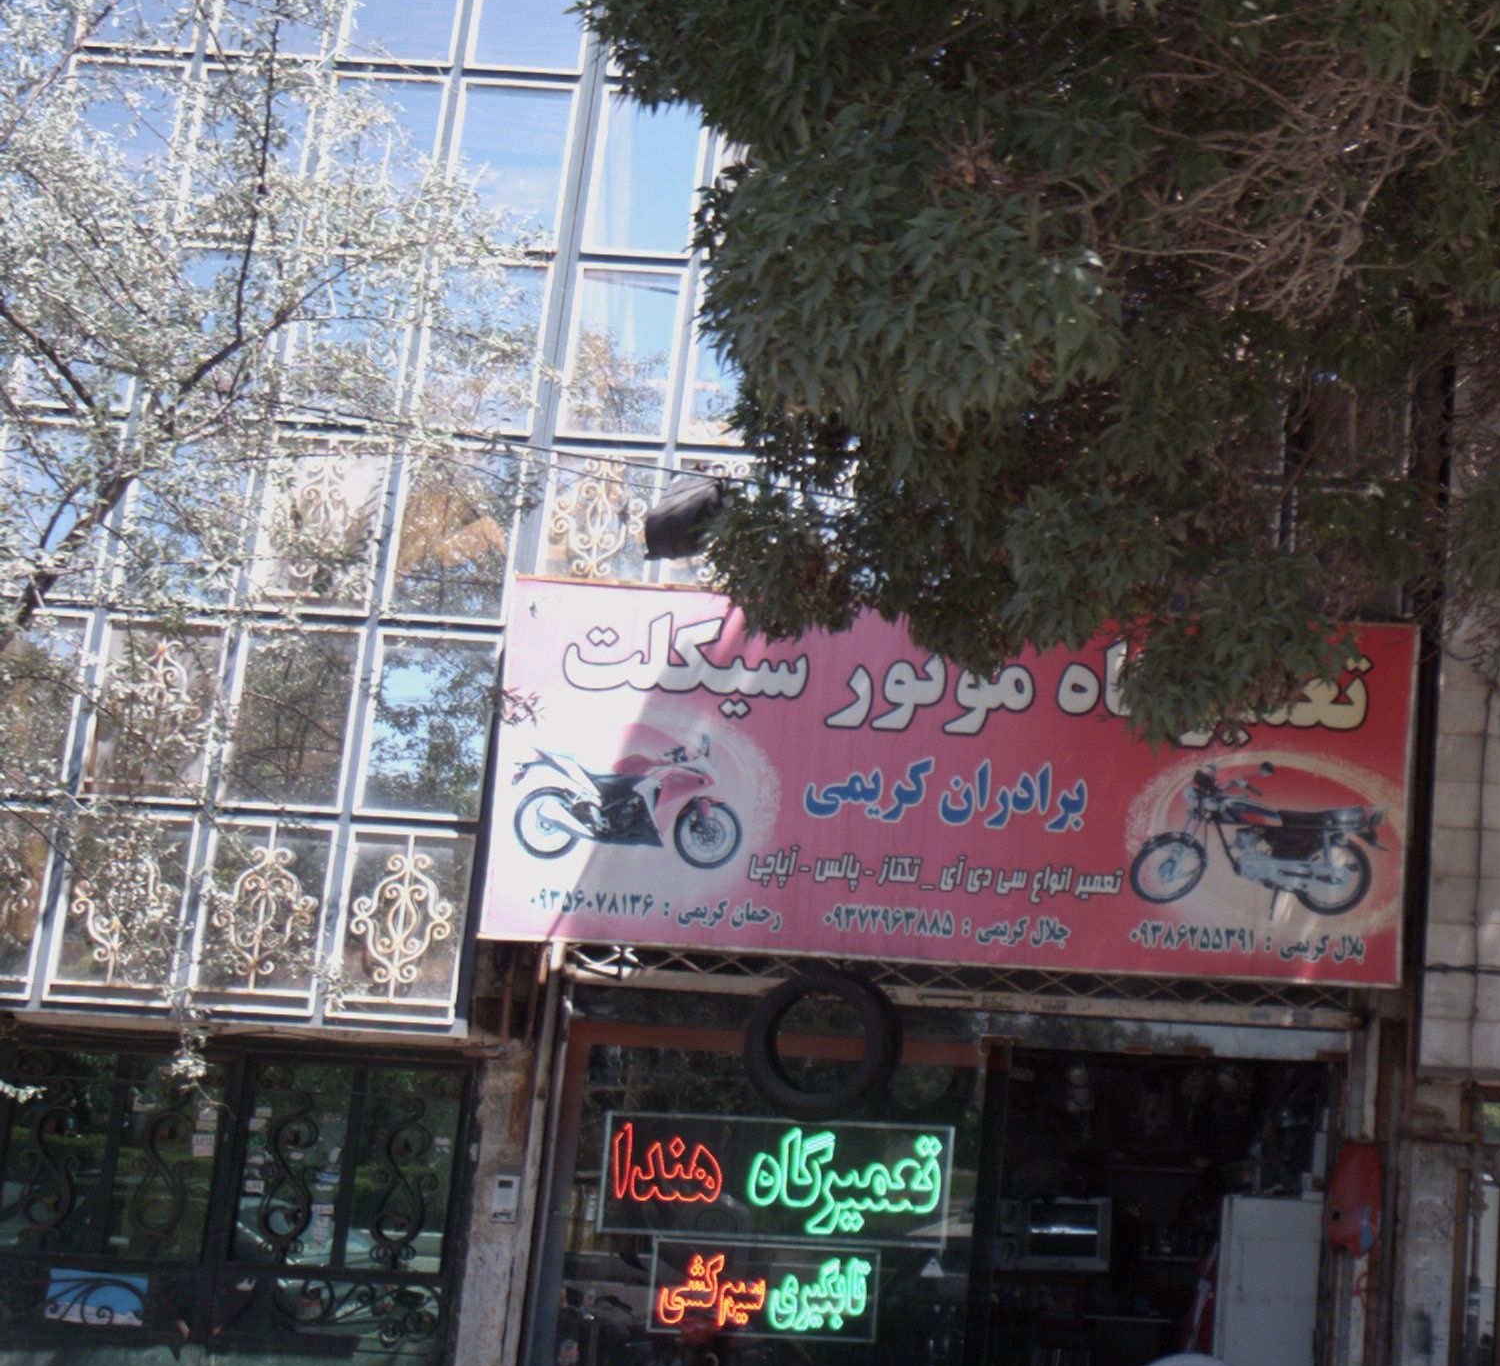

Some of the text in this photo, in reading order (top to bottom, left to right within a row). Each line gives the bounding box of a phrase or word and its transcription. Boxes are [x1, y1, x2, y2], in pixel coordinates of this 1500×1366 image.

[562, 612, 808, 718] سیکلت
[805, 757, 1088, 831] برادران کریمی
[748, 843, 802, 890] آپاچی
[812, 852, 862, 892] پالس
[938, 854, 968, 892] آی
[966, 865, 993, 893] دی
[995, 869, 1028, 895] سی
[1029, 865, 1074, 904] انواع
[1073, 869, 1124, 899] تعمیر
[676, 897, 729, 928] کریمی
[730, 899, 782, 932] رحمان
[975, 916, 1029, 946] کریمی
[1031, 917, 1071, 949] جلال
[1278, 934, 1332, 963] کریمی
[1332, 934, 1368, 967] بلال
[611, 1121, 943, 1235] تعمیرگاه هندا
[656, 1252, 727, 1325] کشی
